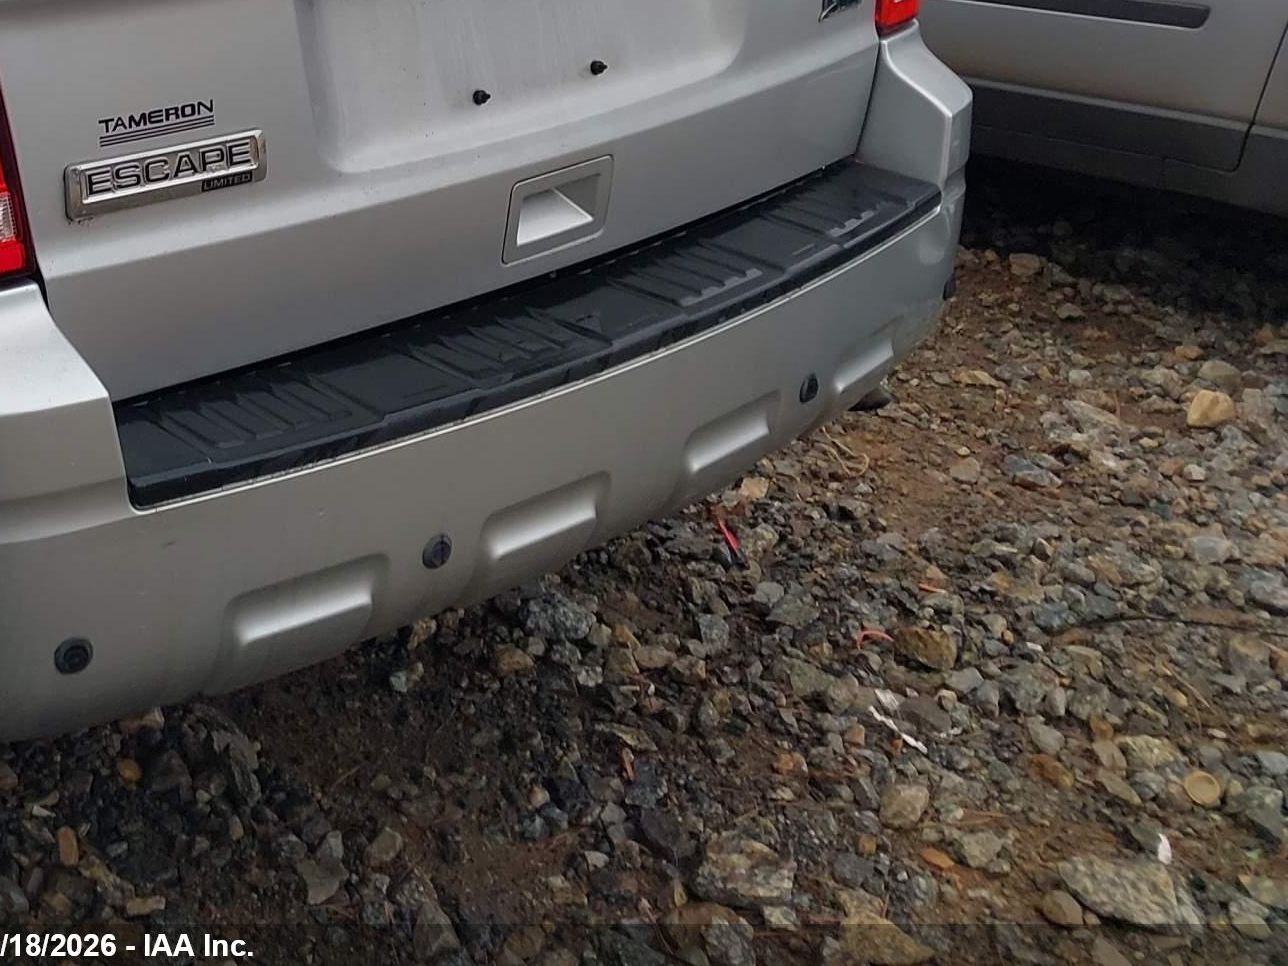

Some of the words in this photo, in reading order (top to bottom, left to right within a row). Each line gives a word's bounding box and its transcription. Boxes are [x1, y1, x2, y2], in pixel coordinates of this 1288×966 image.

[98, 99, 214, 134] TAMERON
[87, 140, 253, 196] ESCAPE
[203, 172, 252, 191] LIMITED
